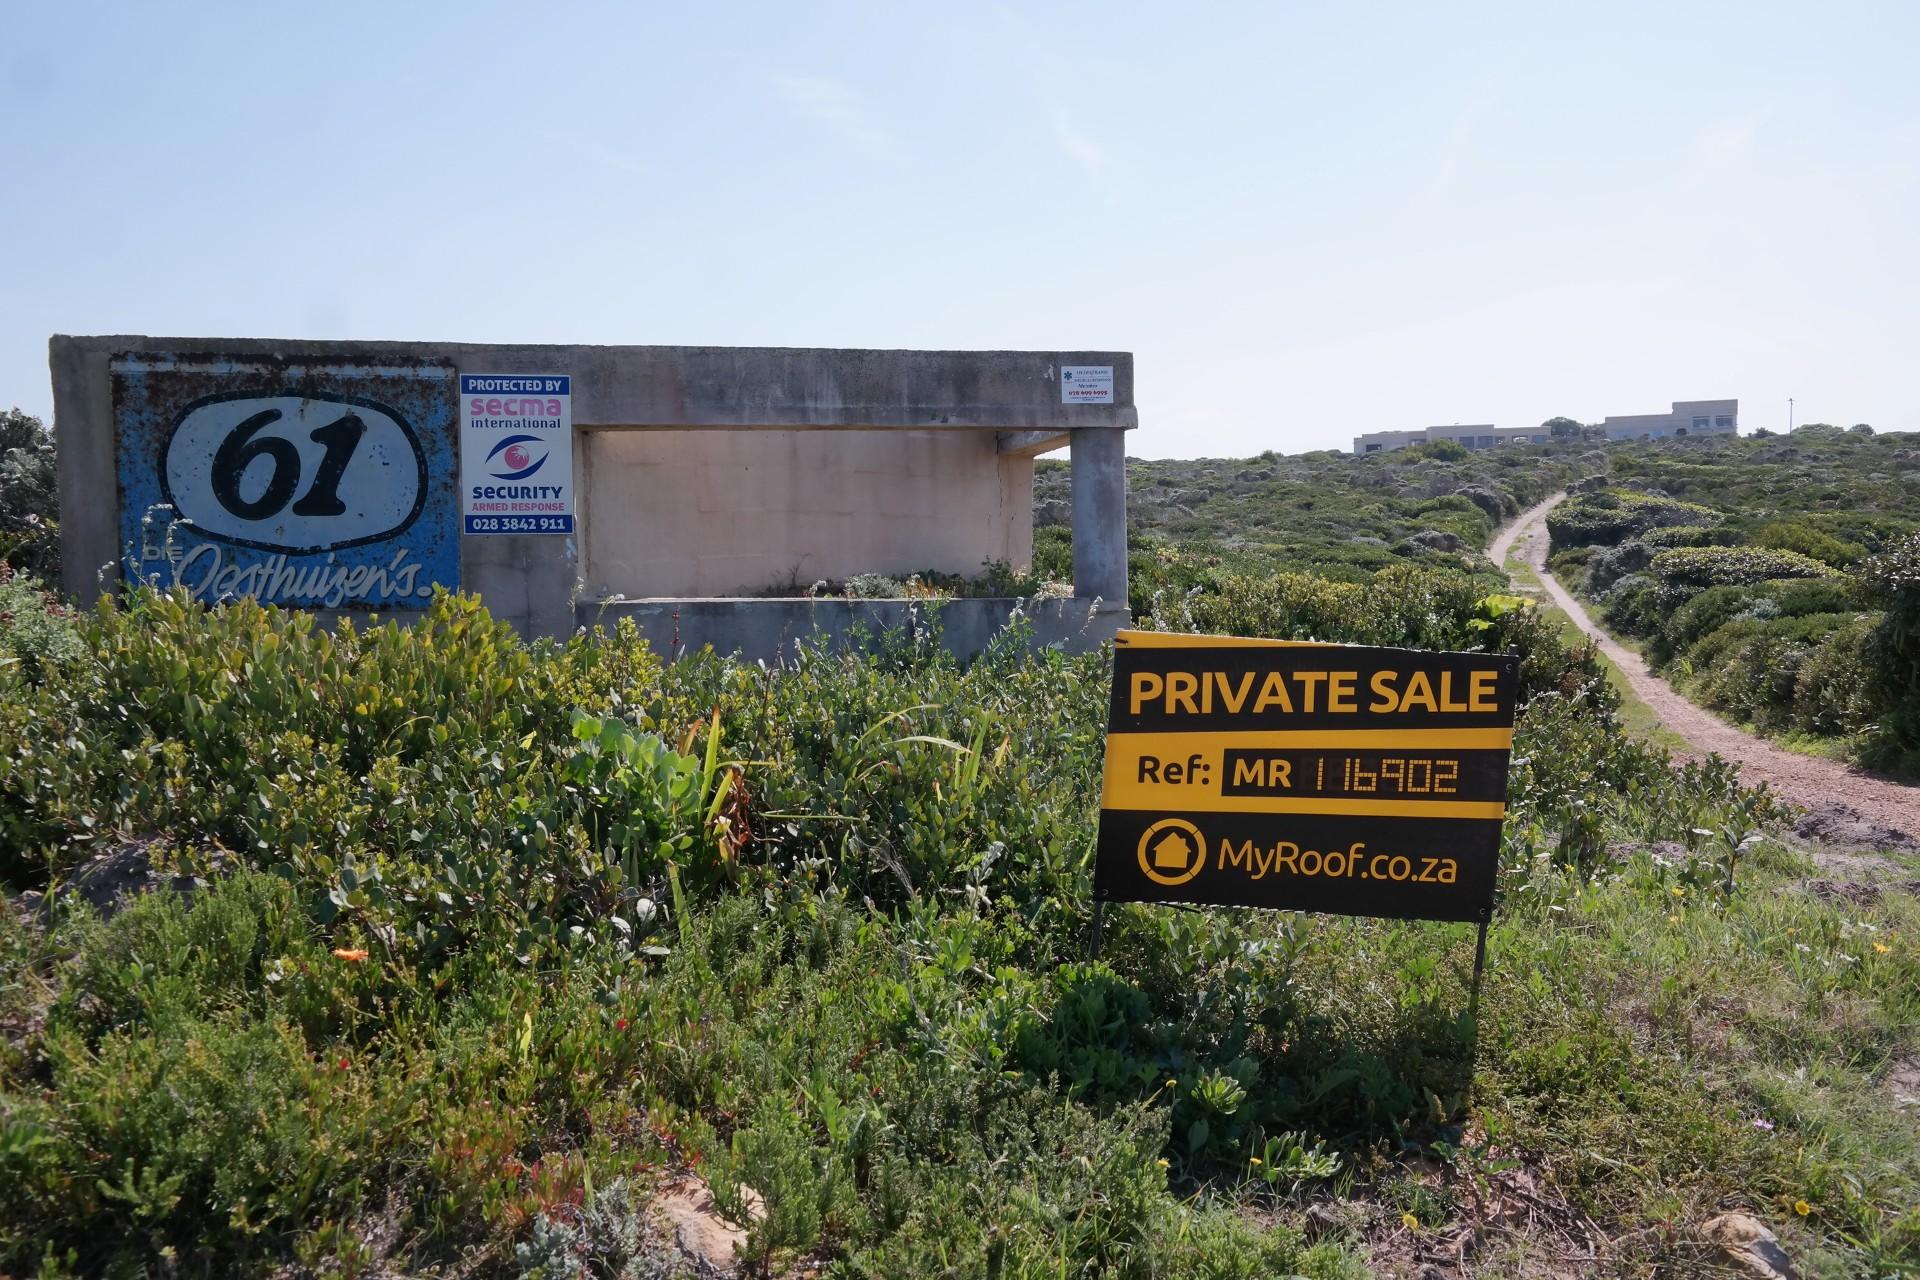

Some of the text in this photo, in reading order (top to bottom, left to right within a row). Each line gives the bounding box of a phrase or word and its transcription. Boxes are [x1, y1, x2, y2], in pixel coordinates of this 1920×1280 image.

[469, 379, 562, 391] PROTECTED BY
[470, 398, 561, 416] secma
[471, 418, 561, 429] international
[211, 408, 367, 520] 61
[472, 502, 565, 511] ARMED RESPONSE
[473, 518, 565, 530] 028 3842 911
[143, 545, 184, 561] DIE
[1130, 670, 1498, 714] PRIVATE SALE
[1137, 754, 1210, 785] Ref:
[1233, 758, 1291, 787] MR
[1218, 838, 1457, 883] MyRoof.co.za
